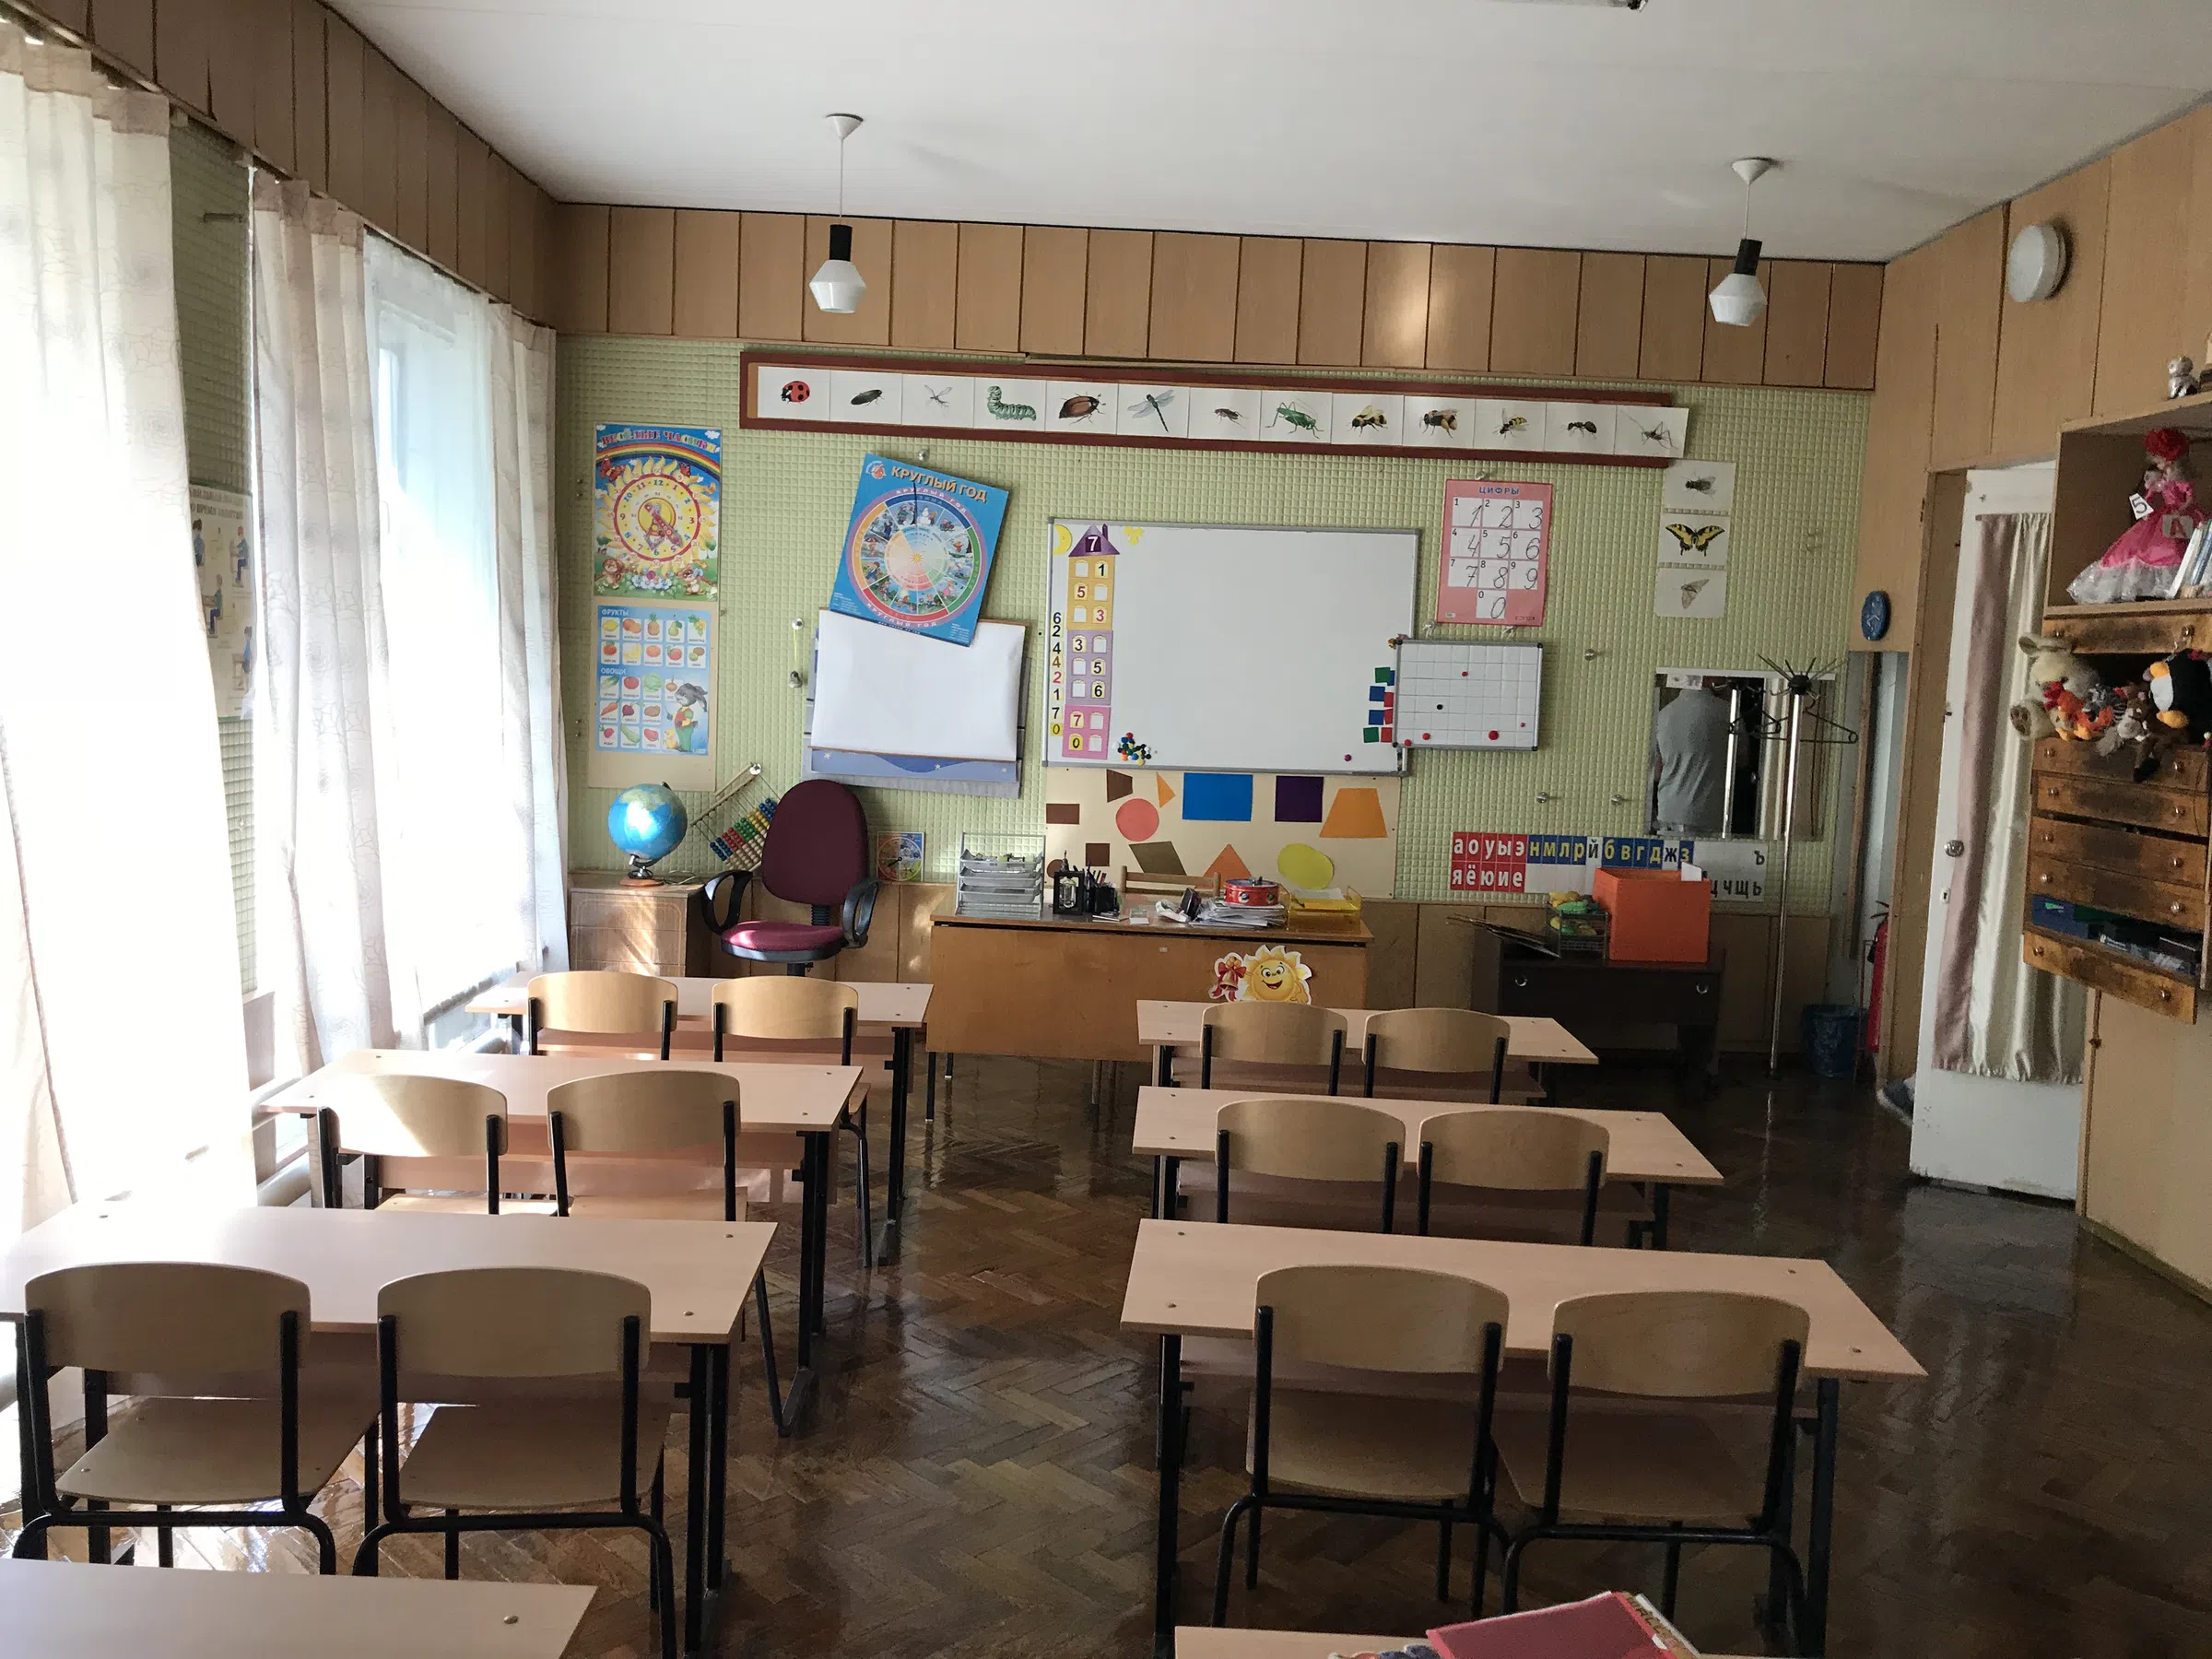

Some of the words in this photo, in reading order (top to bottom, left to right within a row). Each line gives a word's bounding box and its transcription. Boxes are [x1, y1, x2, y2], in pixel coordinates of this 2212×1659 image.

[636, 482, 646, 490] 11
[891, 465, 958, 493] КРУГЛЫЙ
[959, 484, 988, 504] ГОД
[624, 492, 632, 502] 10
[1478, 487, 1519, 495] ЦИФРЫ
[896, 488, 945, 499] КРУГЛЫЙ
[949, 499, 967, 513] ГОД
[2132, 498, 2147, 513] 5
[1471, 505, 1482, 526] 1
[1499, 506, 1512, 528] 2
[1529, 507, 1543, 529] 3
[1512, 531, 1518, 539] 6
[1088, 536, 1099, 551] 7
[1467, 535, 1480, 557] 4
[1497, 536, 1511, 559] 5
[1525, 537, 1540, 559] 6
[1099, 564, 1104, 576] 1
[1480, 560, 1486, 569] 8
[1511, 561, 1516, 570] 9
[1465, 565, 1478, 587] 7
[1493, 567, 1508, 589] 8
[1524, 568, 1538, 590] 9
[1077, 586, 1086, 598] 5
[602, 608, 629, 617] ФРУКТЫ
[1490, 597, 1506, 618] 0
[866, 603, 911, 628] КРУГЛЫЙ
[1053, 612, 1061, 624] 6
[1096, 609, 1104, 622] 3
[1052, 625, 1061, 637] 2
[1053, 642, 1061, 654] 4
[1075, 639, 1083, 651] 3
[1053, 656, 1061, 667] 4
[600, 667, 627, 676] ОВОЩИ
[1093, 662, 1101, 674] 5
[1053, 671, 1062, 684] 2
[1053, 688, 1059, 700] 1
[1094, 685, 1102, 697] 6
[1052, 707, 1060, 719] 7
[1073, 715, 1081, 726] 7
[1053, 724, 1060, 735] 0
[1072, 737, 1080, 748] 0
